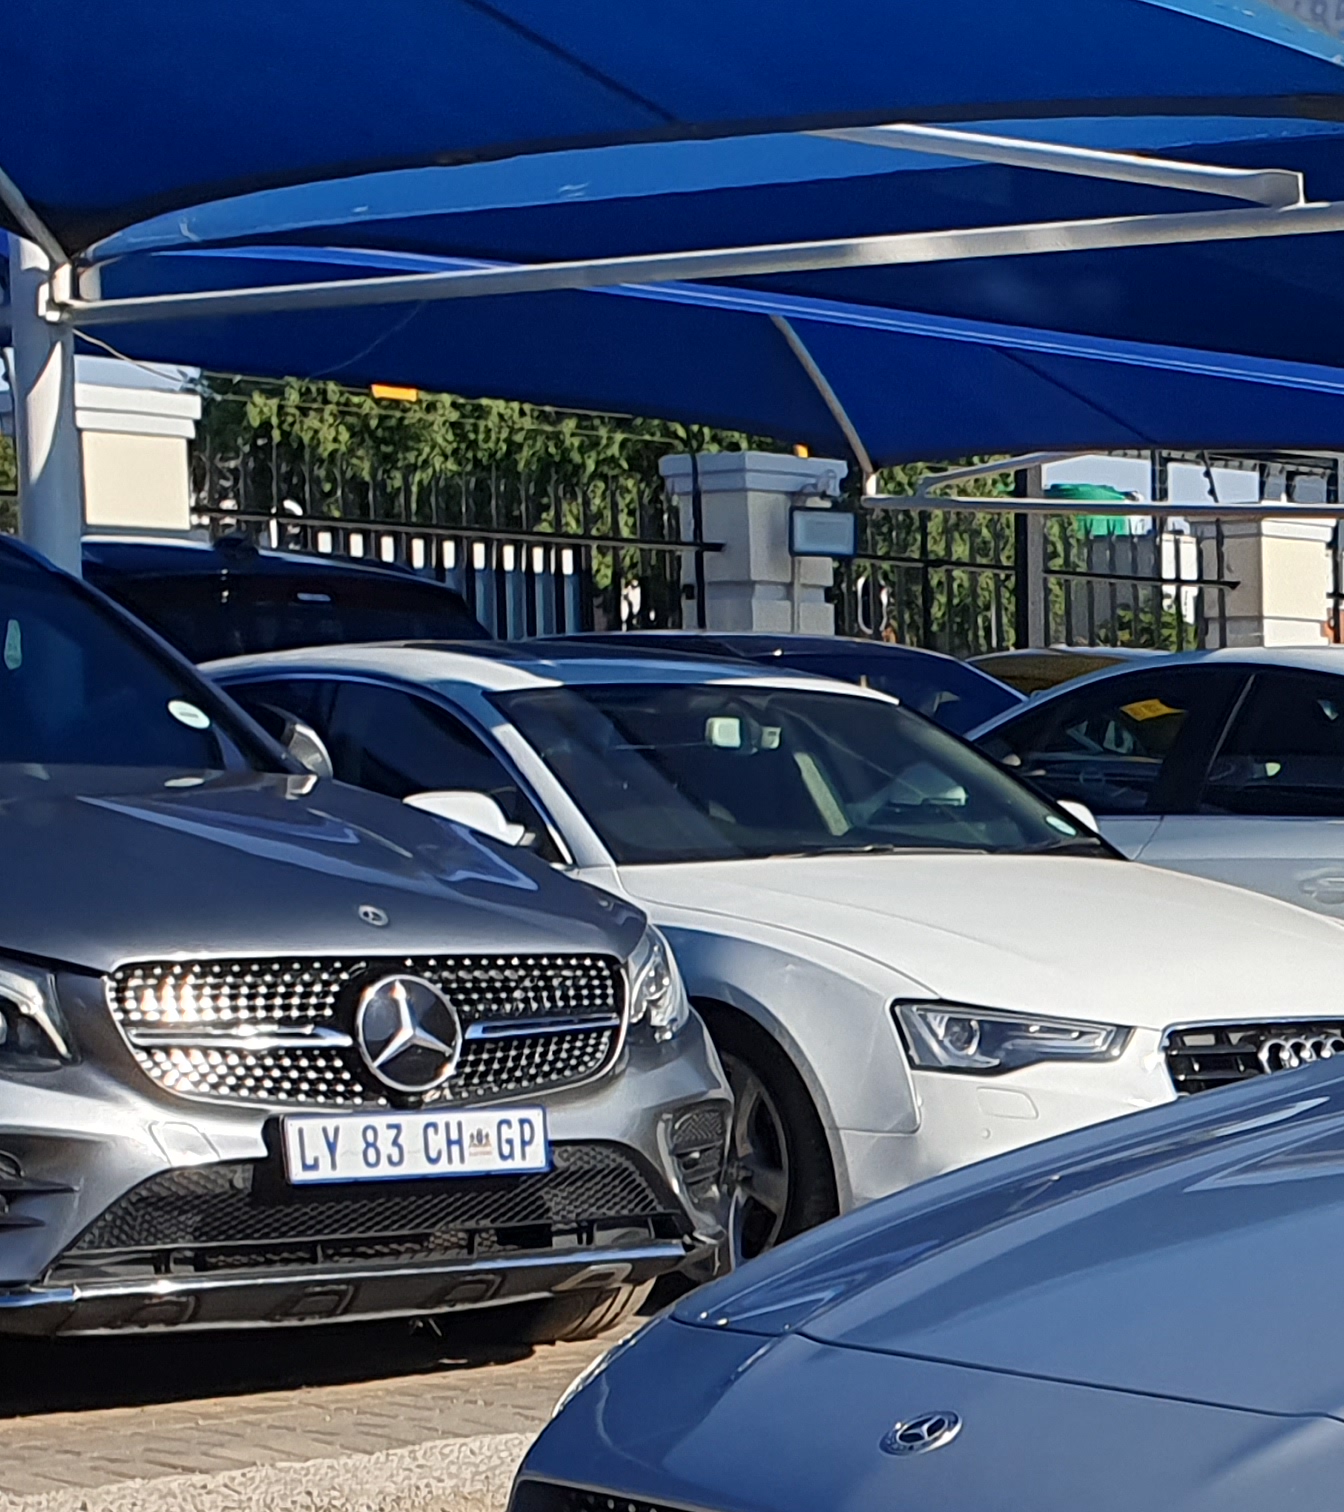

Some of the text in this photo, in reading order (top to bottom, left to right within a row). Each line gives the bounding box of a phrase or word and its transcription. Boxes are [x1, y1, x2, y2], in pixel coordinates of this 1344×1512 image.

[296, 1117, 536, 1172] LY 83 CH GP
